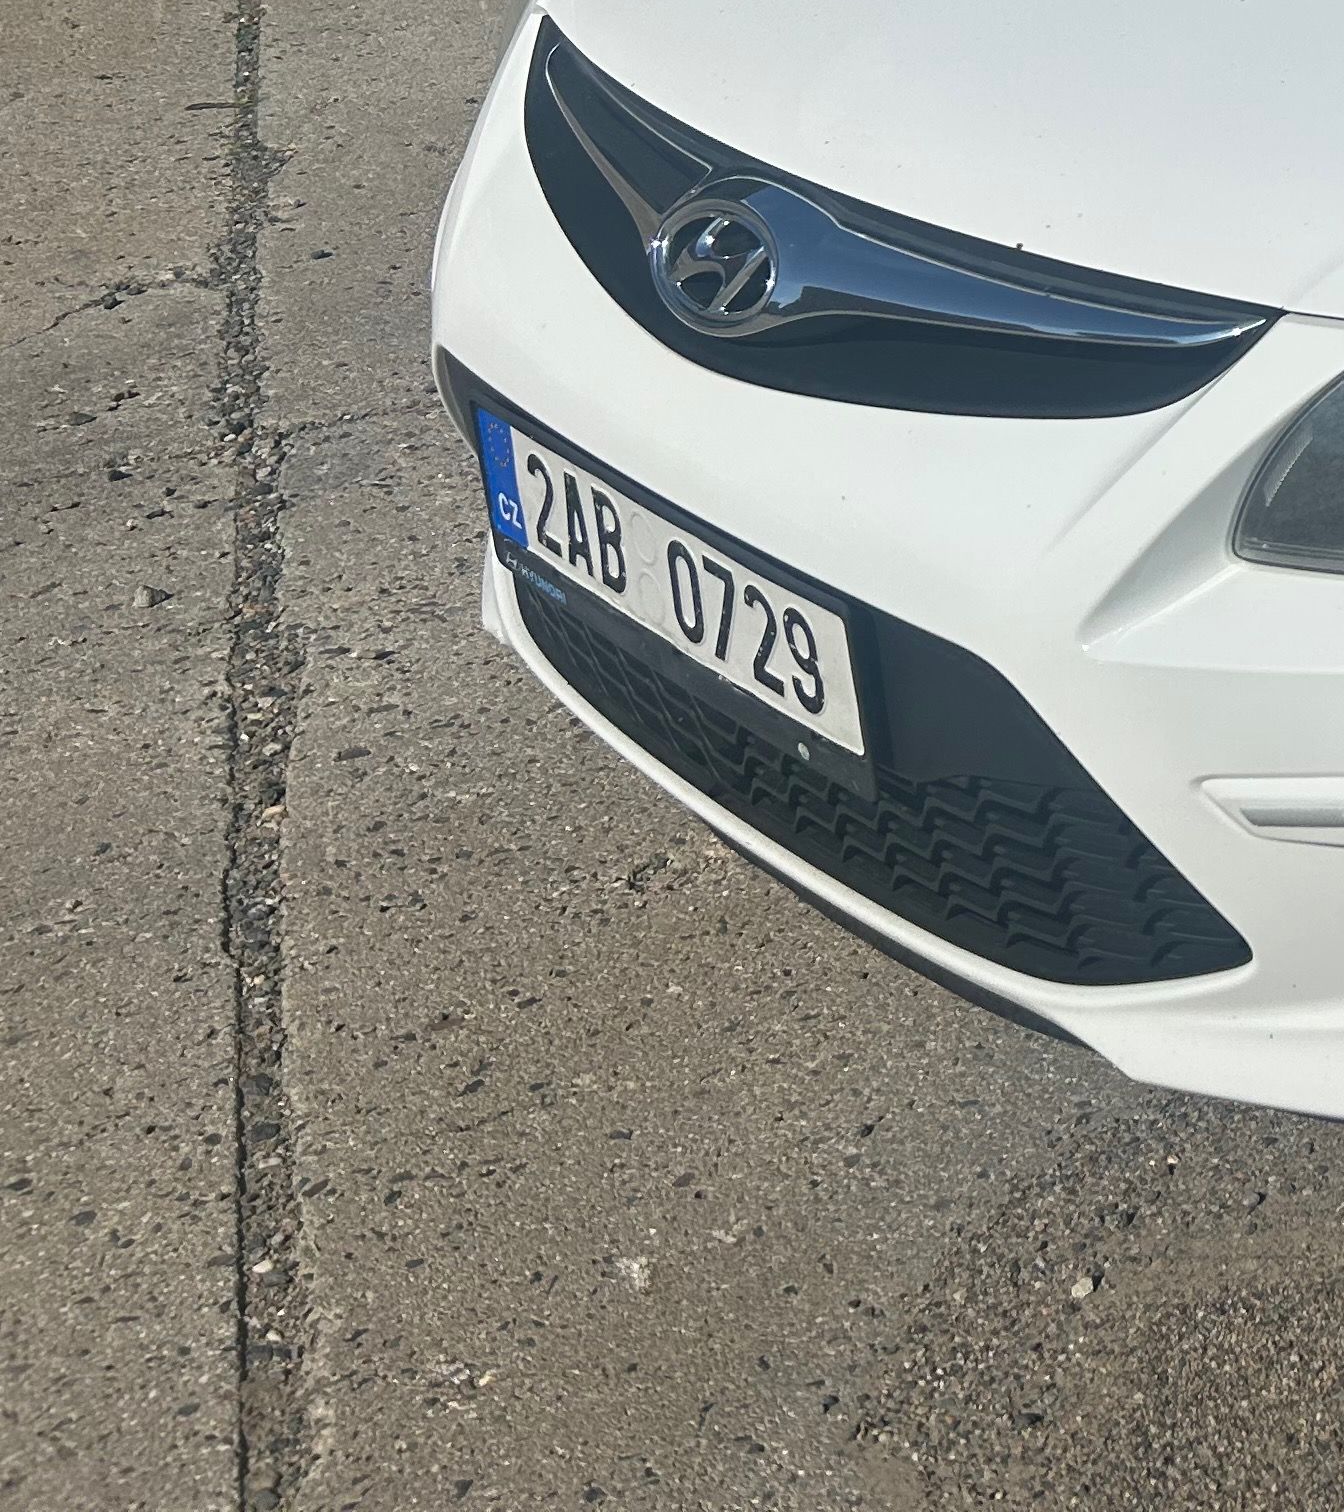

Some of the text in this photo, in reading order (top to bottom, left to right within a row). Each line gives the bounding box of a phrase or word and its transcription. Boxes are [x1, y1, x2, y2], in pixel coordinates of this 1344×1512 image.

[499, 492, 523, 529] CZ
[526, 453, 825, 714] 2AB 0729
